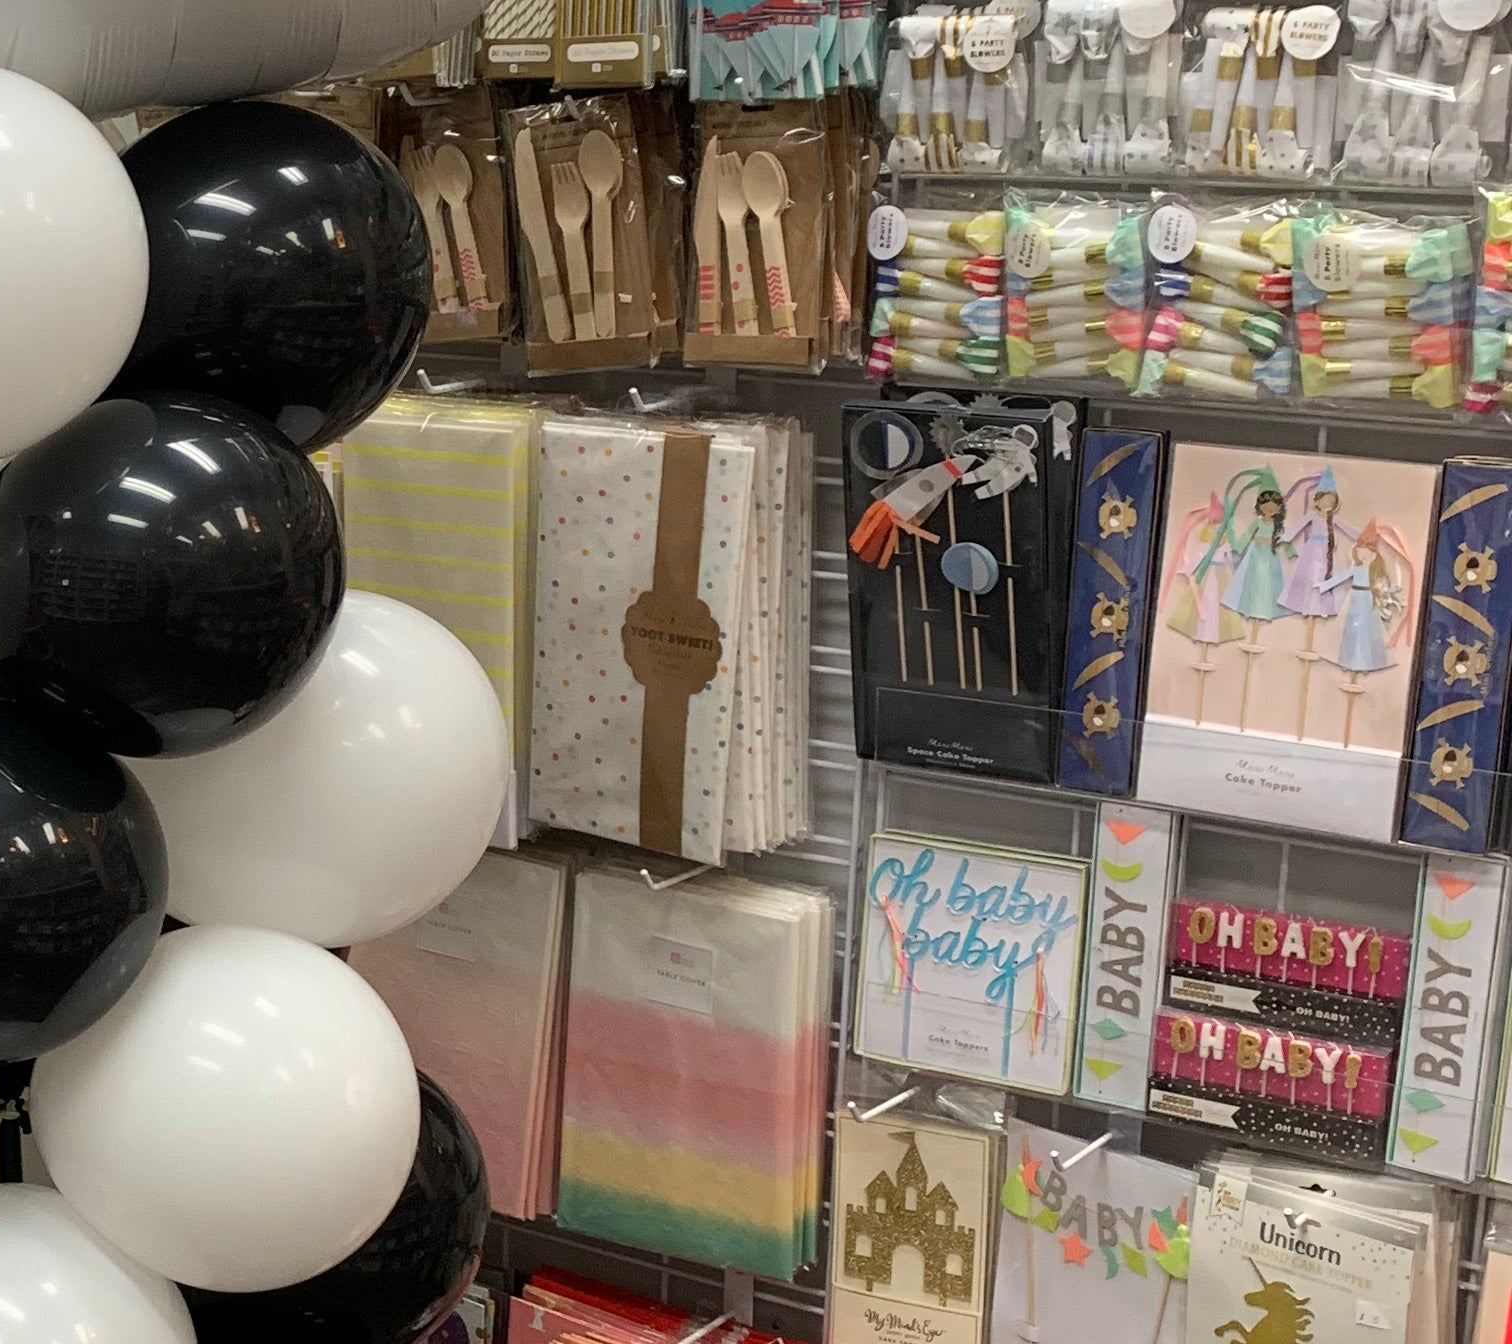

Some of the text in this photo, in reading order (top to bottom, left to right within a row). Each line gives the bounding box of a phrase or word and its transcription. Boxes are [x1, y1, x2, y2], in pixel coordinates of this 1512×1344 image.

[906, 745, 994, 765] Space Cake Topper
[1224, 772, 1303, 794] Cake Topper
[869, 848, 1077, 953] Oh baby
[903, 900, 1040, 1004] baby
[1095, 886, 1149, 1020] BABY
[1187, 906, 1385, 976] OH BABY!
[1315, 1008, 1351, 1025] BABY!
[1414, 947, 1474, 1089] BABY
[1170, 1017, 1363, 1090] OH BABY!
[1293, 1125, 1330, 1142] BABY!
[1042, 1168, 1146, 1252] BABY
[1258, 1221, 1342, 1266] Unicorn
